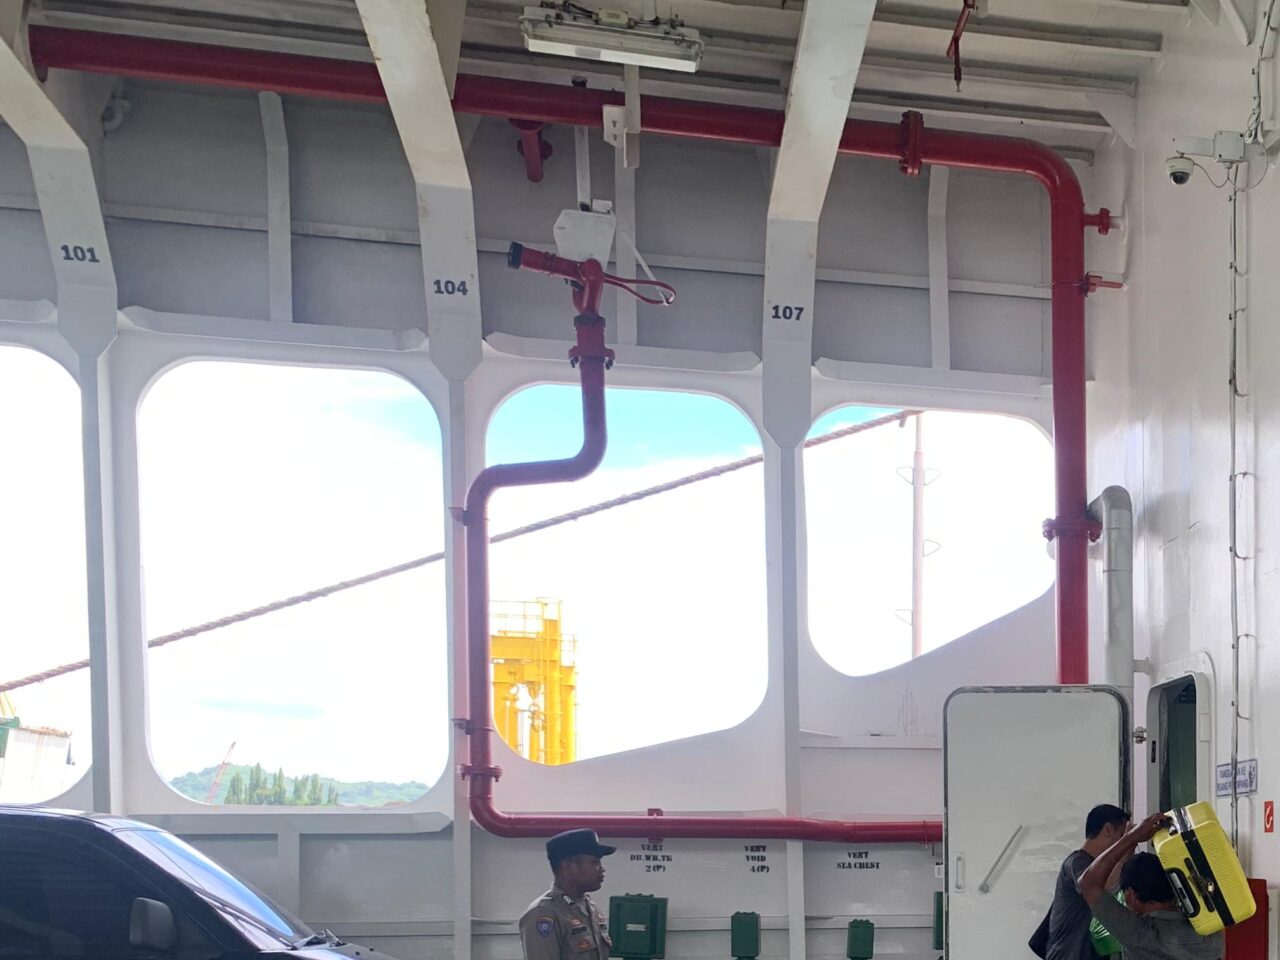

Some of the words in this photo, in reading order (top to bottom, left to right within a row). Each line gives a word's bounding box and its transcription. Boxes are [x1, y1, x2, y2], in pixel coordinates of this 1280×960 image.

[60, 244, 100, 264] 101
[432, 279, 469, 297] 104
[771, 305, 805, 322] 107
[746, 855, 767, 863] VOID
[836, 861, 852, 870] SEA
[853, 861, 881, 870] CHEST
